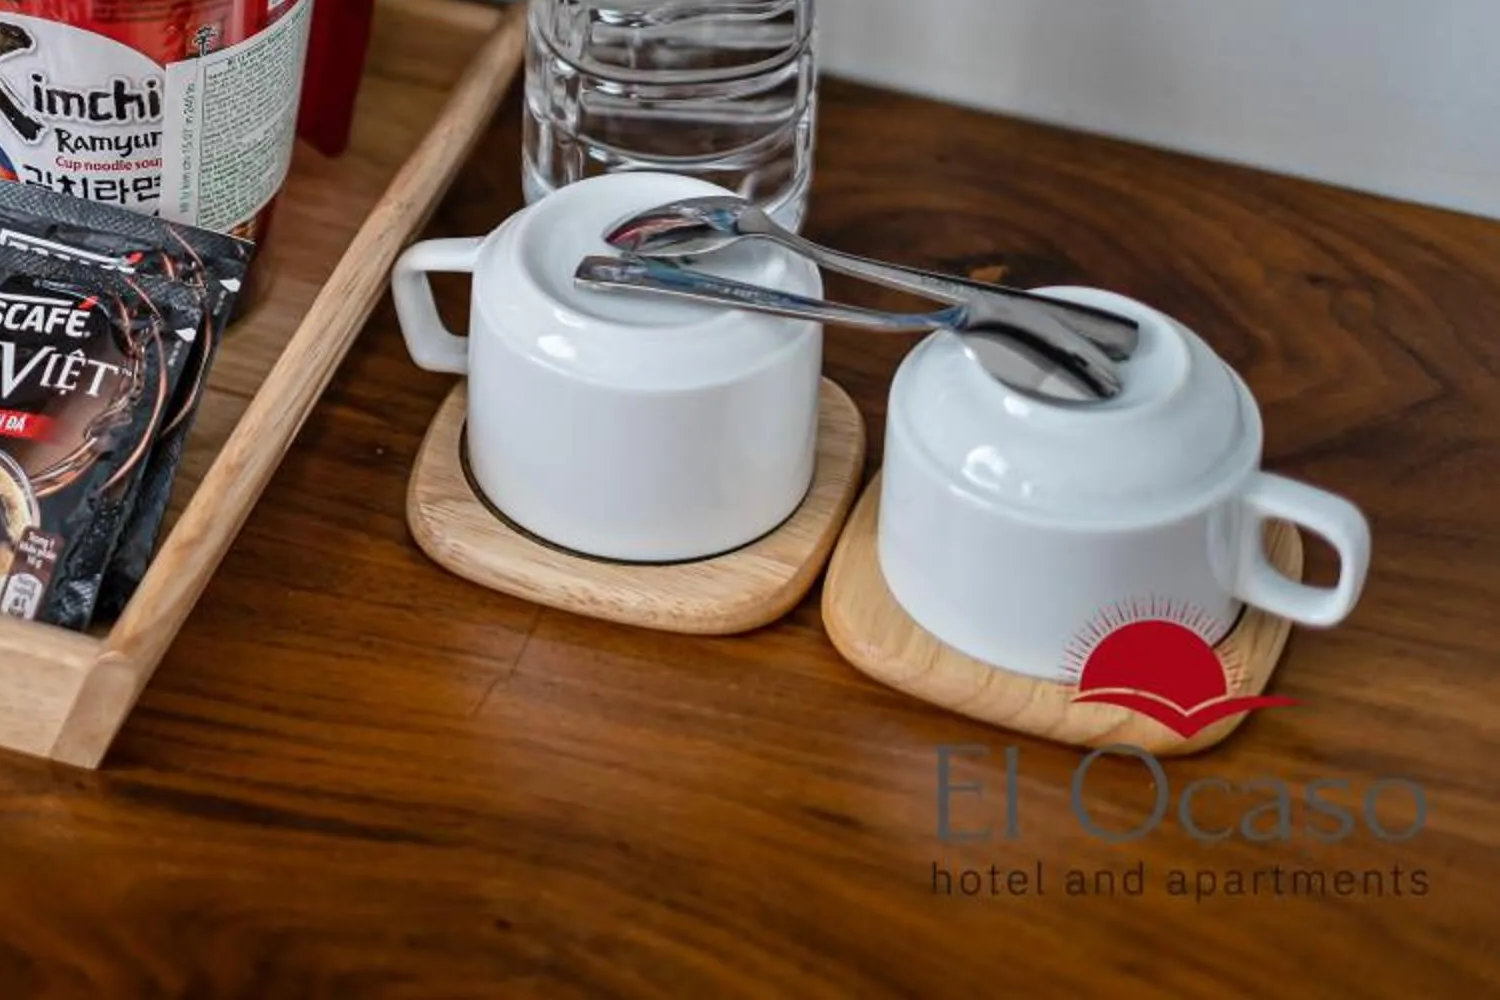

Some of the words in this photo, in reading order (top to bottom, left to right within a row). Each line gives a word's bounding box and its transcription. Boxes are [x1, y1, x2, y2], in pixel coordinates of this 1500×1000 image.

[55, 155, 82, 173] Cup
[84, 158, 132, 172] noodle
[134, 157, 163, 169] sou
